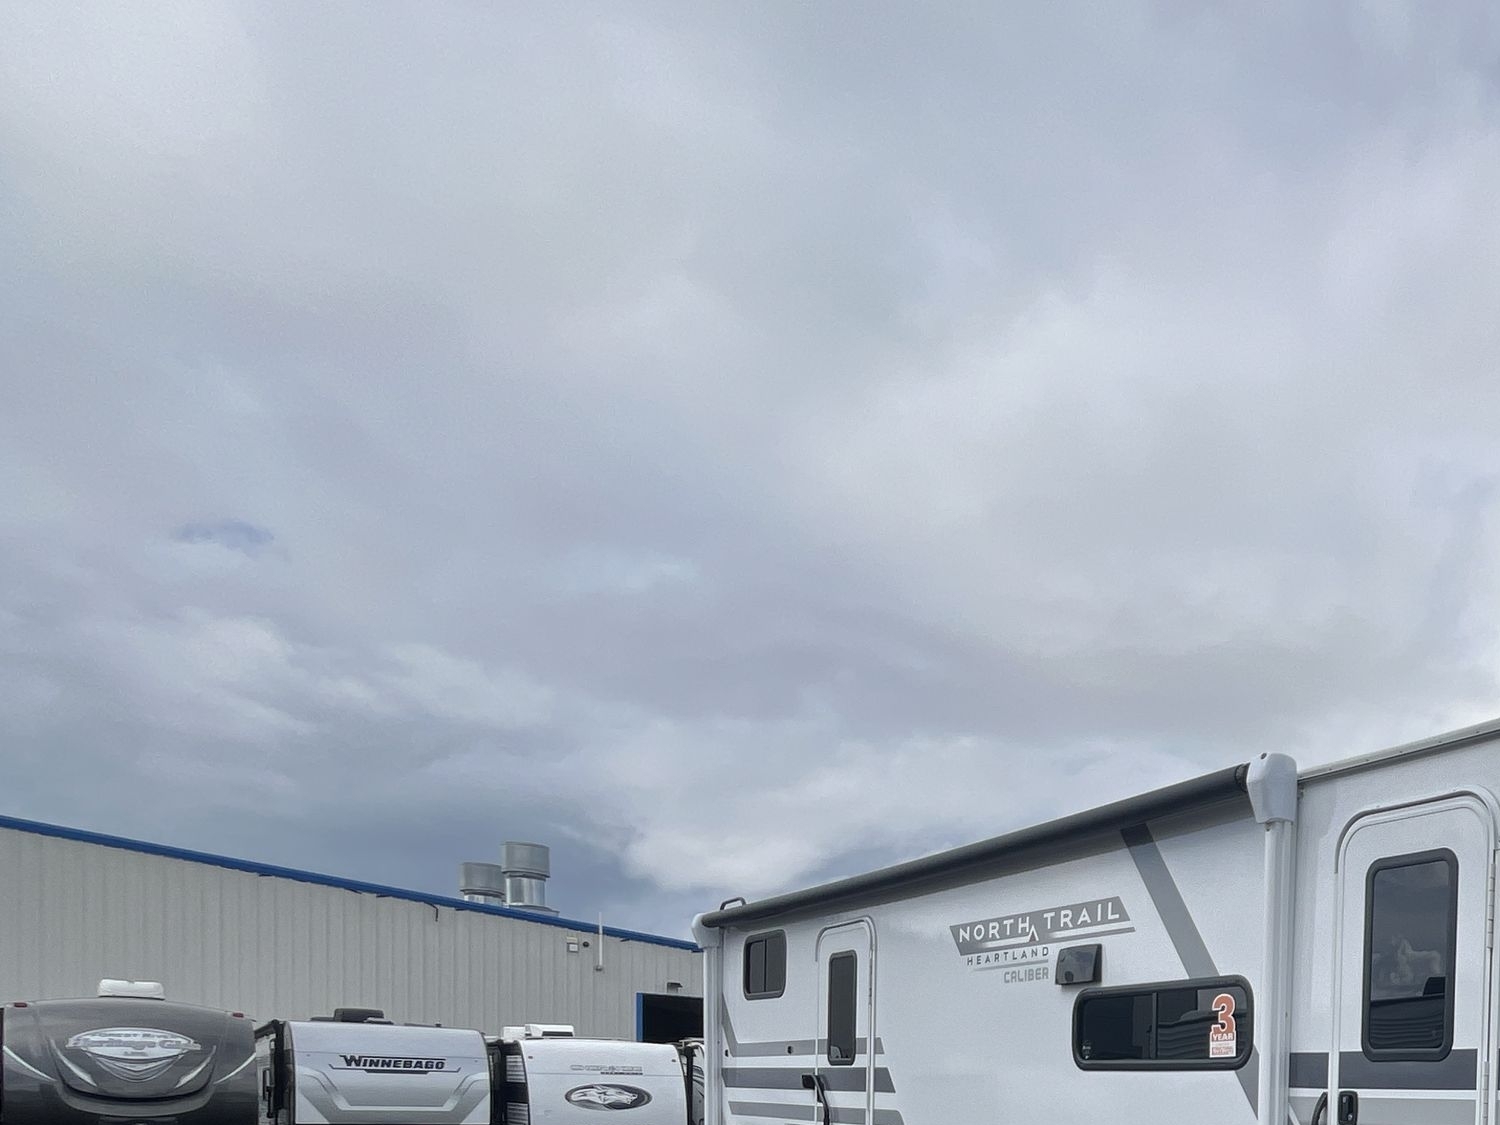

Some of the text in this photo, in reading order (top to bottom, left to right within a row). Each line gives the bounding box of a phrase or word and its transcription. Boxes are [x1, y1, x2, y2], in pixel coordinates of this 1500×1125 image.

[958, 902, 1120, 943] NORTH TRAIL
[966, 946, 1049, 966] HEARTLAND
[1003, 966, 1049, 984] CALIBER
[1211, 993, 1236, 1034] 3
[1211, 1032, 1234, 1041] YEAR
[339, 1055, 446, 1070] WINNEBAGO
